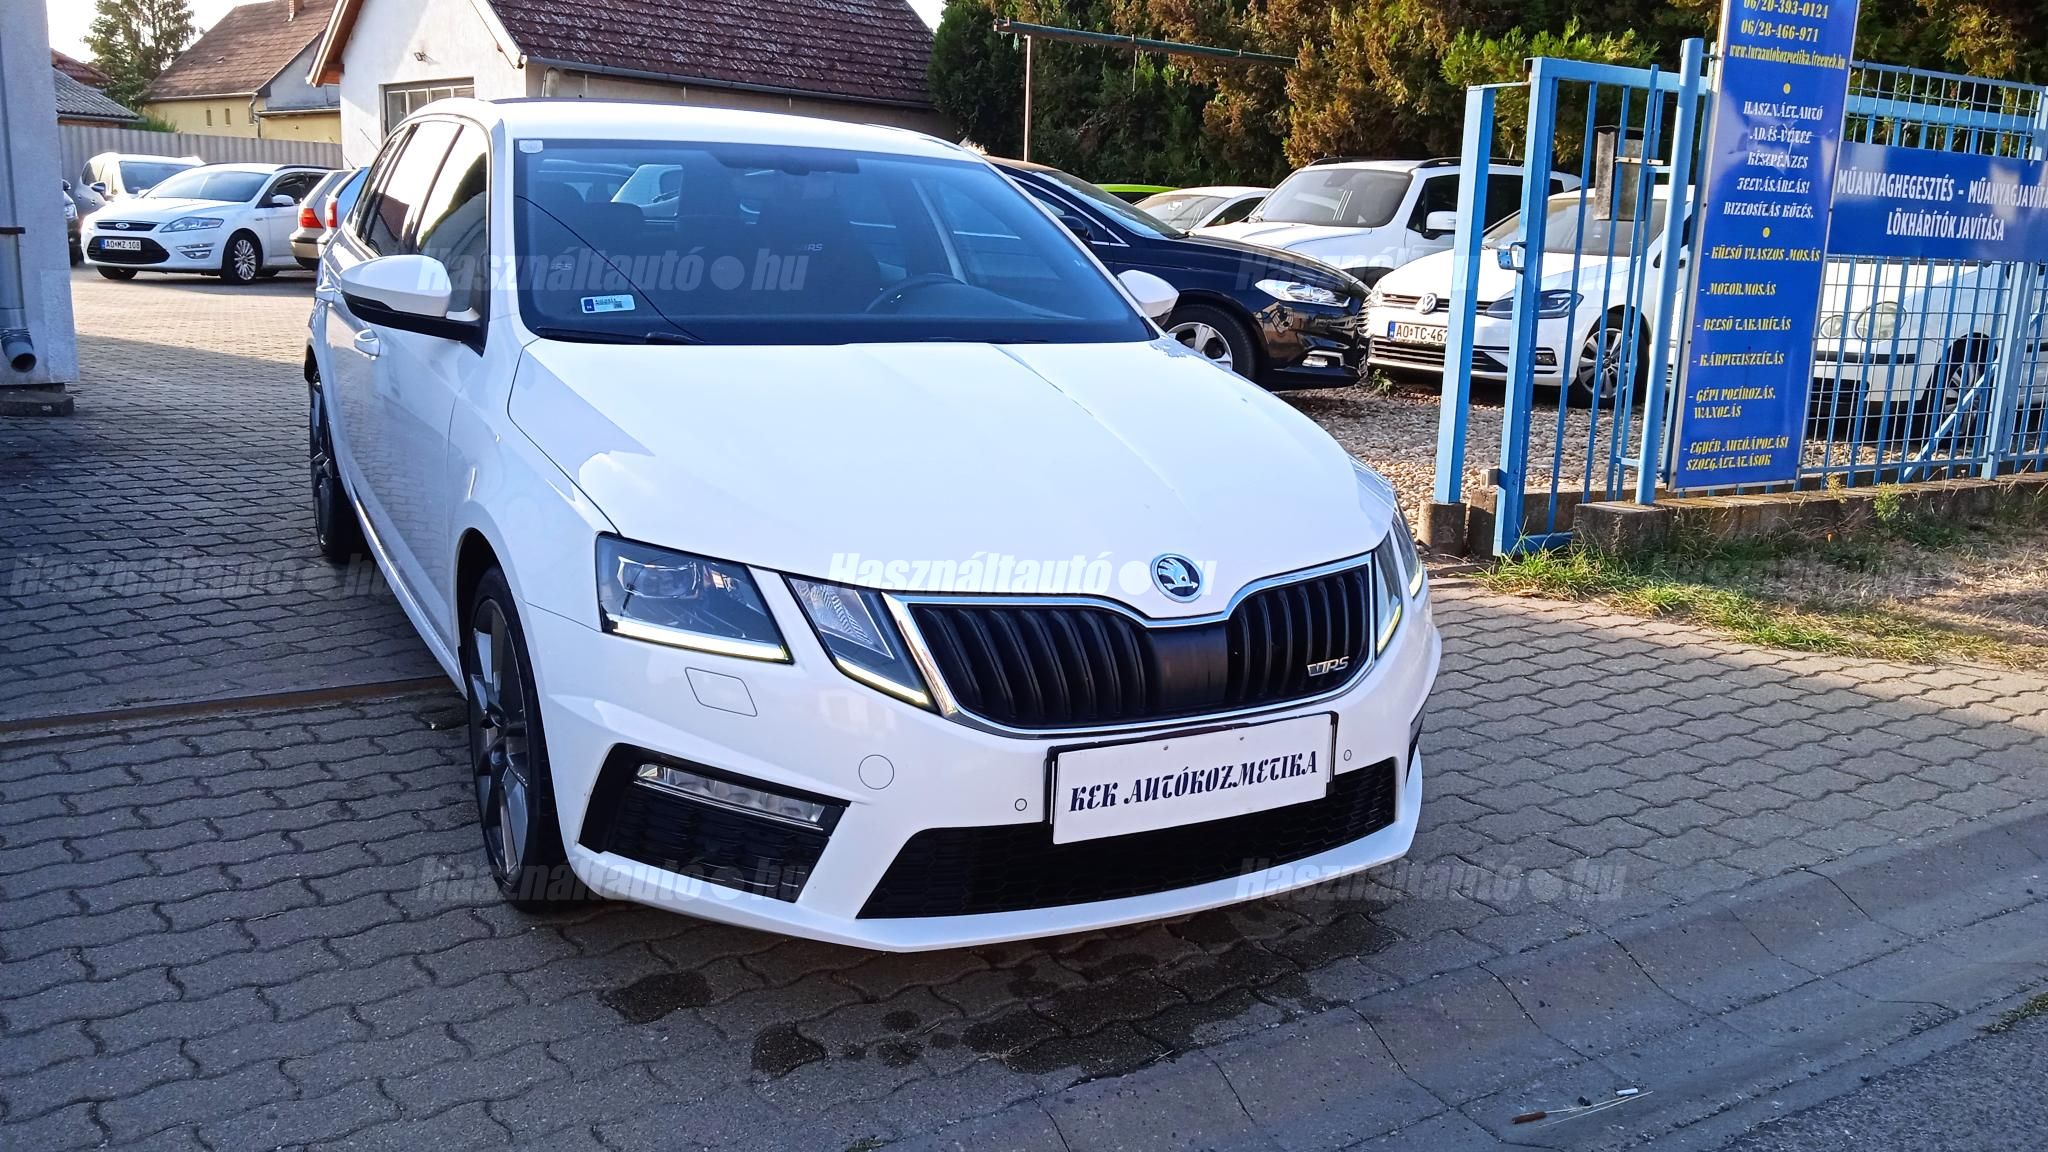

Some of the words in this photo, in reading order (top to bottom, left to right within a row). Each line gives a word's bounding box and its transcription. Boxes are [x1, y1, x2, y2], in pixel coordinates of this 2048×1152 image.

[1741, 19, 1819, 42] 06/28-466-971
[1747, 151, 1809, 169] KÉSZPÉNZES
[1837, 167, 1955, 203] MŰANYAGHEGESZTÉS
[1723, 200, 1781, 217] BIZTOSÍTÁS
[1886, 208, 1957, 239] LÖKHÁRÍTÓK
[1956, 212, 2004, 241] JAVÍTÁSA
[1734, 315, 1792, 331] TAKARÍTÁS
[1696, 386, 1719, 403] GÉPI
[1694, 403, 1742, 420] WAXOLÁS
[1690, 438, 1721, 455] EGYÉB
[1686, 452, 1772, 471] SZOLGÁLTATÁSOK
[1069, 783, 1118, 812] KEK
[1123, 751, 1318, 804] AUTÓKOZMETIKA
